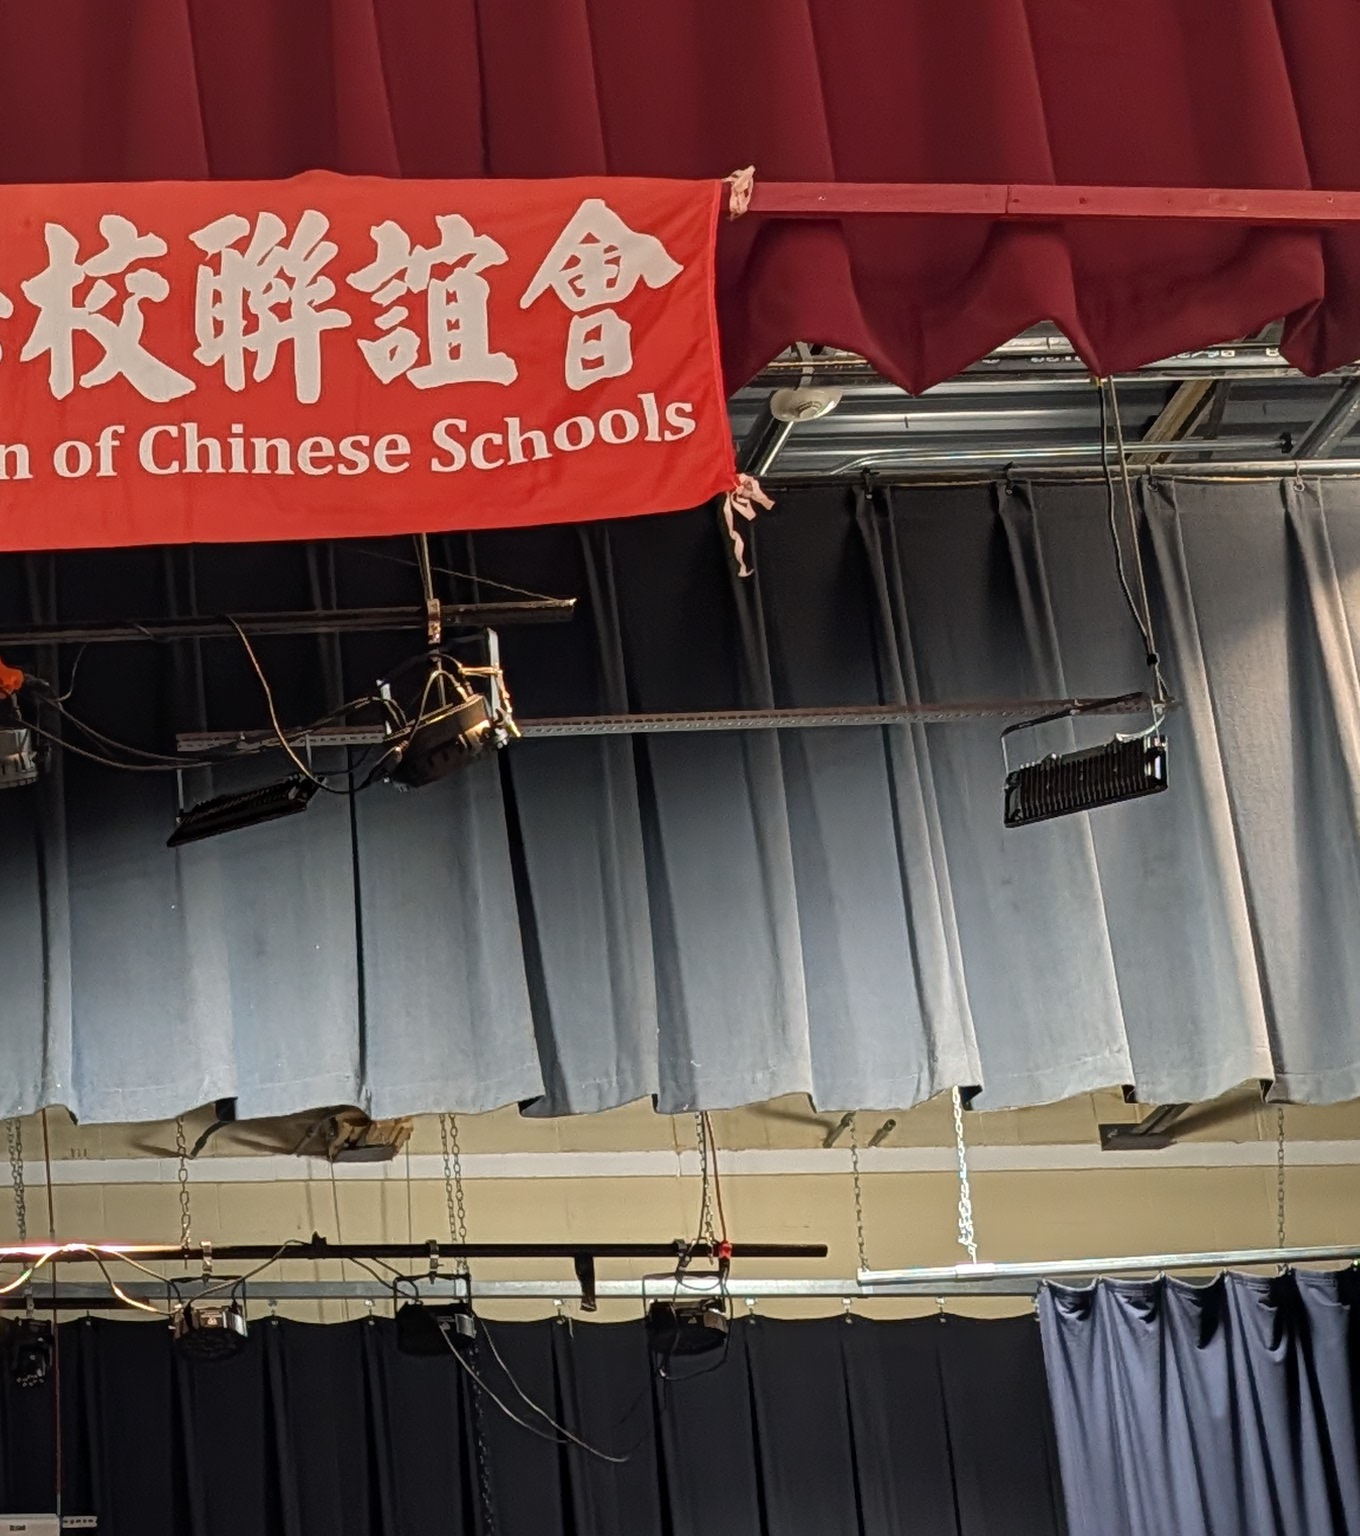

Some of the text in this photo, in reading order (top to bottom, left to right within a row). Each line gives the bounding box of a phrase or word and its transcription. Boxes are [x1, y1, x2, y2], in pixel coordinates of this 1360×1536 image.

[53, 424, 125, 478] of
[139, 422, 411, 482] Chinese
[431, 392, 696, 472] Schools
